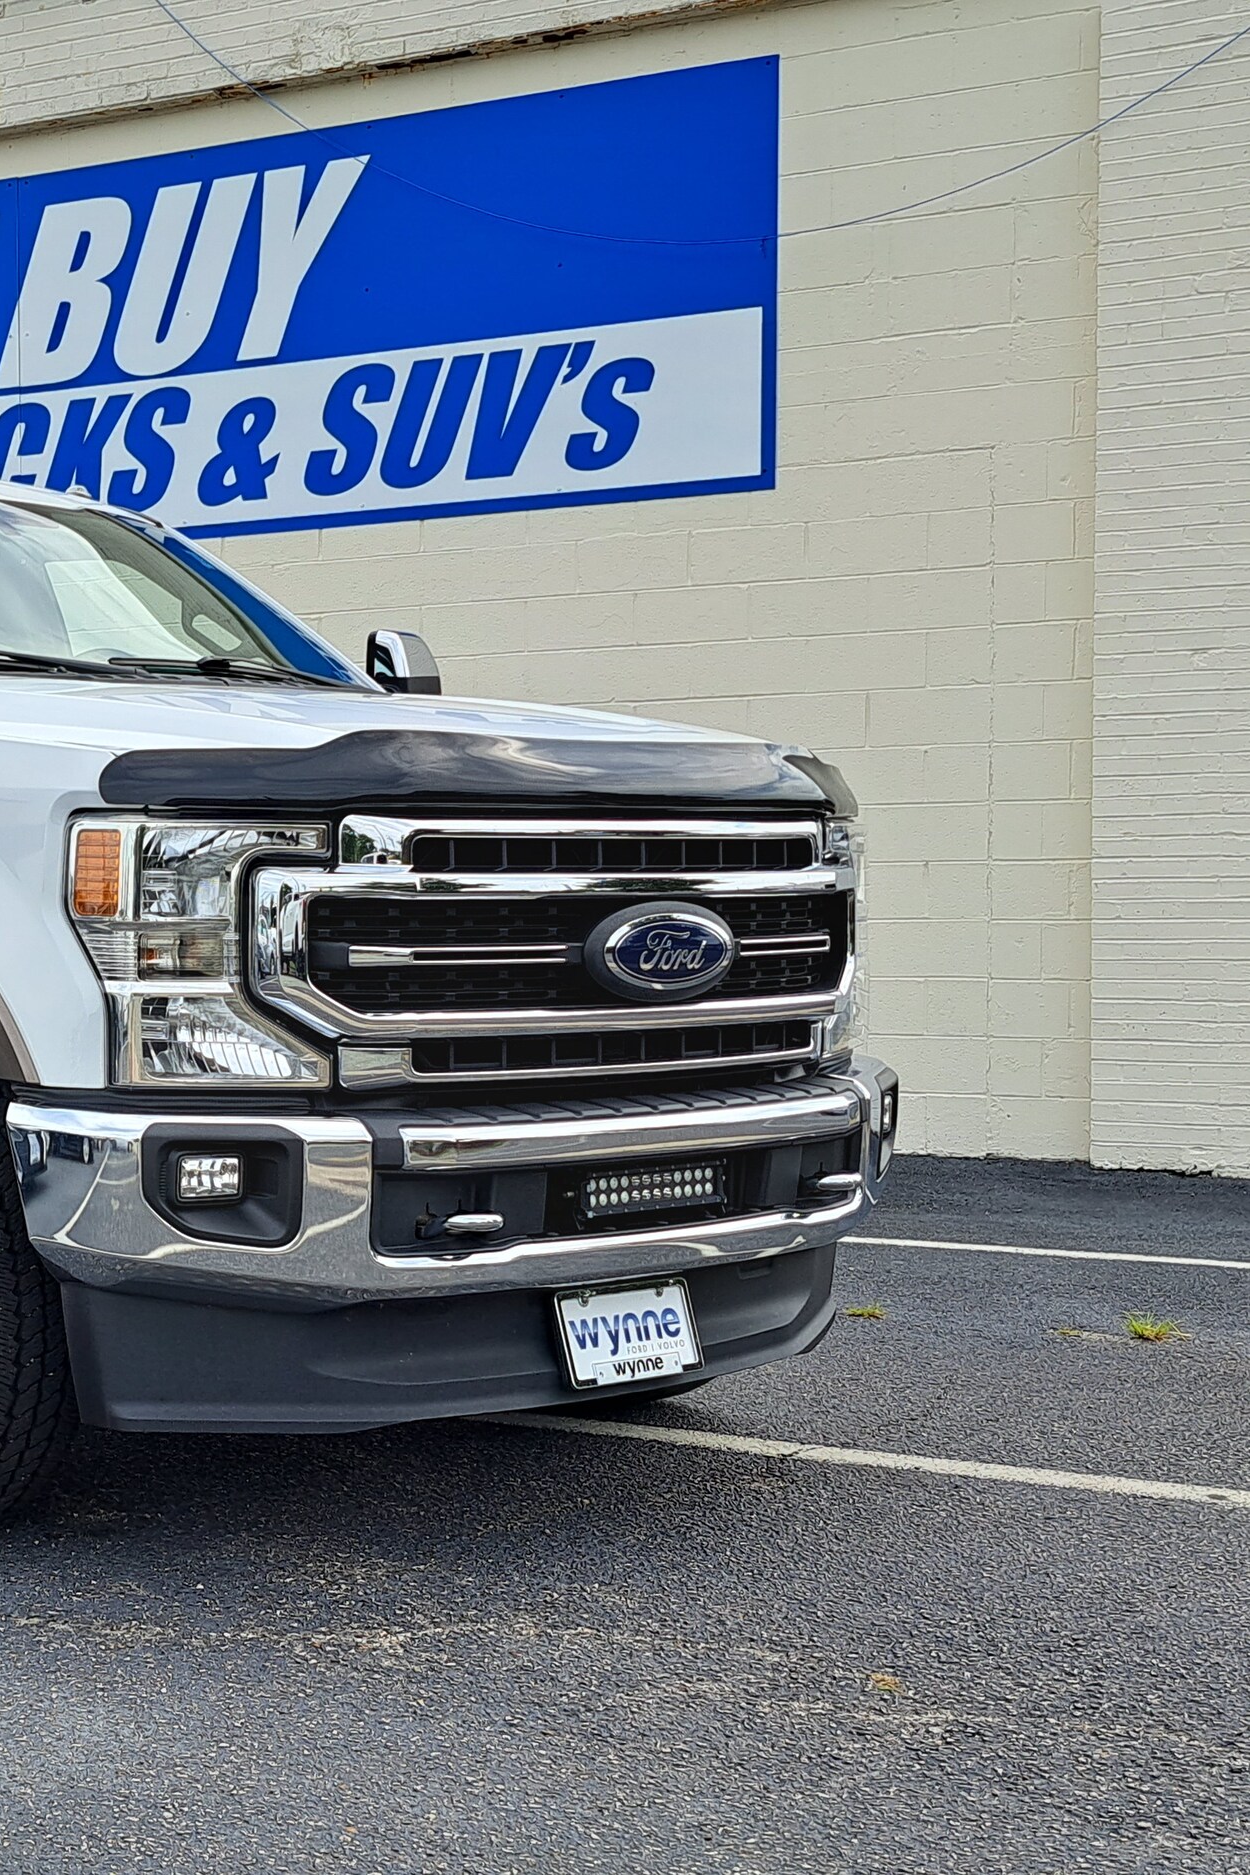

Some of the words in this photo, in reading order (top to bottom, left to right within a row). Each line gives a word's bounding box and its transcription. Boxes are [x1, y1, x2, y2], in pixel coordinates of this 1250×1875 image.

[197, 396, 281, 507] &
[639, 929, 708, 972] Ford
[568, 1307, 682, 1356] wynne
[627, 1344, 648, 1355] FORD
[657, 1339, 686, 1350] VOLVO
[613, 1356, 664, 1378] wynne
